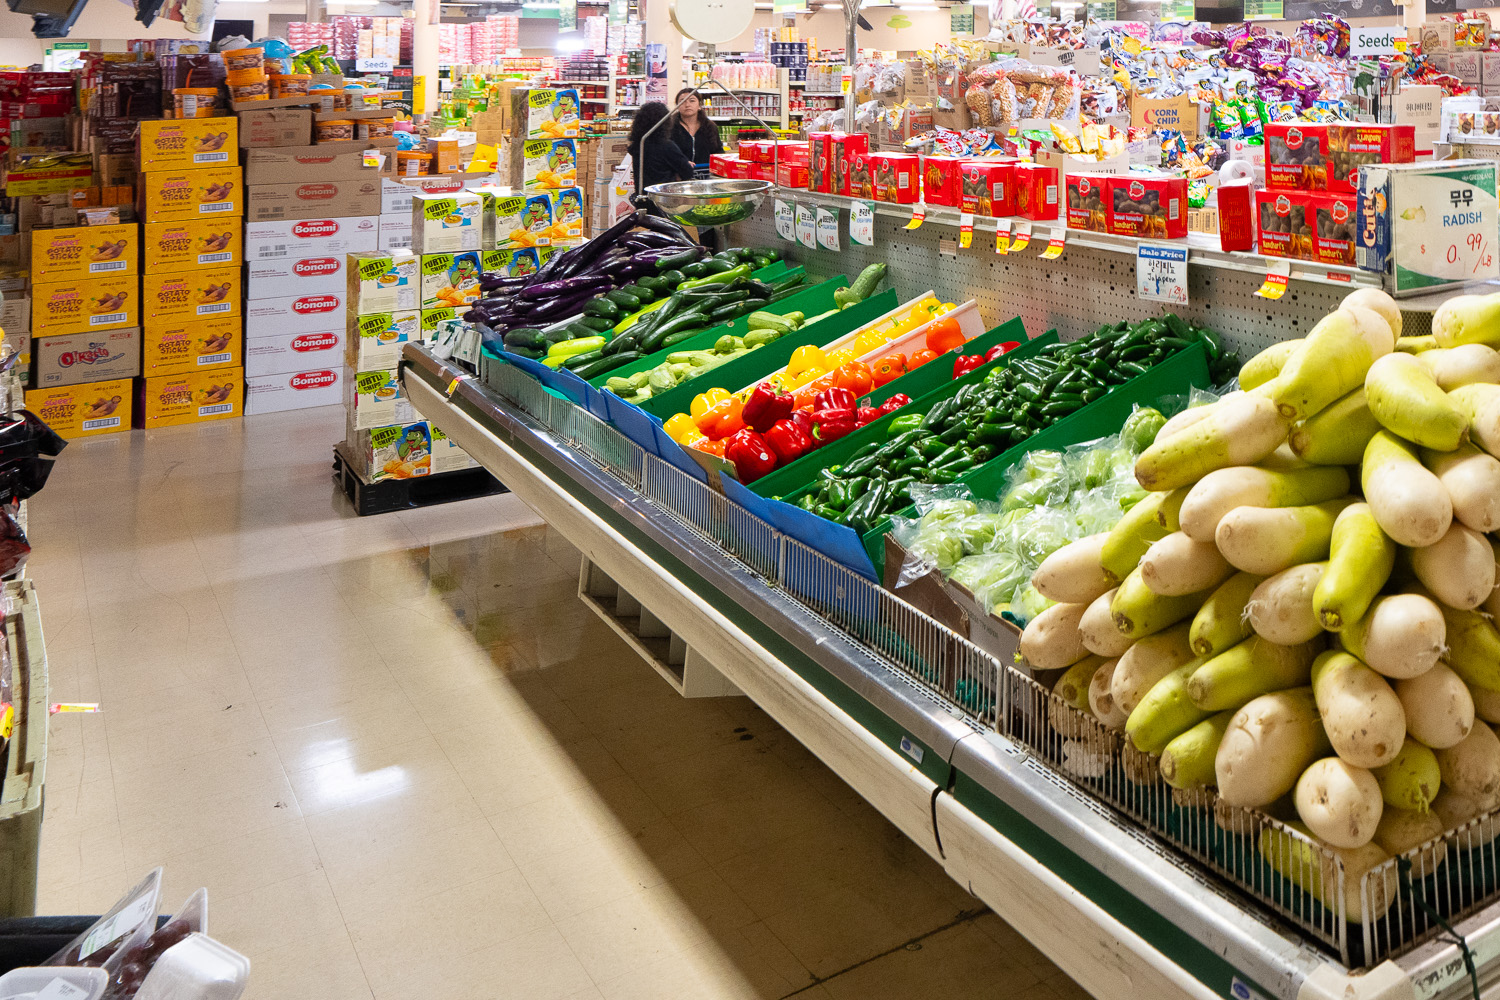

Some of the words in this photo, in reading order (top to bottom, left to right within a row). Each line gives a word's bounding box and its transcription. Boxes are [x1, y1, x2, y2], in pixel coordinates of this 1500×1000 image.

[1358, 33, 1395, 48] Seeds
[364, 60, 388, 69] Seeds
[1155, 109, 1178, 117] CORN
[1157, 116, 1180, 125] CHIPS
[154, 137, 187, 145] POTATO
[1468, 173, 1494, 181] GREENLAND
[298, 187, 336, 196] Bonomi
[162, 193, 190, 201] STICKS
[1450, 189, 1474, 208] 무우
[426, 201, 451, 214] TURTLE
[497, 197, 522, 211] TURTLE
[1442, 211, 1482, 228] RADISH
[295, 223, 337, 234] Bonomi
[158, 238, 192, 247] POTATO
[47, 246, 83, 255] POTATO
[1140, 248, 1160, 256] Sale
[1160, 250, 1184, 259] Price
[1420, 244, 1426, 254] $
[424, 254, 450, 268] TURTLE
[484, 251, 509, 265] TURTLE
[296, 261, 338, 272] Bonomi
[360, 260, 386, 274] TURTLE
[158, 290, 191, 298] POTATO
[47, 299, 84, 308] POTATO
[295, 298, 337, 310] Bonomi
[49, 305, 80, 313] STICKS
[423, 310, 449, 324] TURTLE
[361, 317, 387, 330] TURTLE
[158, 340, 192, 349] POTATO
[293, 336, 336, 348] Bonomi
[292, 374, 335, 386] Bonomi
[160, 391, 192, 400] POTATO
[44, 397, 75, 407] SWEET
[40, 404, 77, 414] POTATO
[42, 411, 75, 420] STICKS
